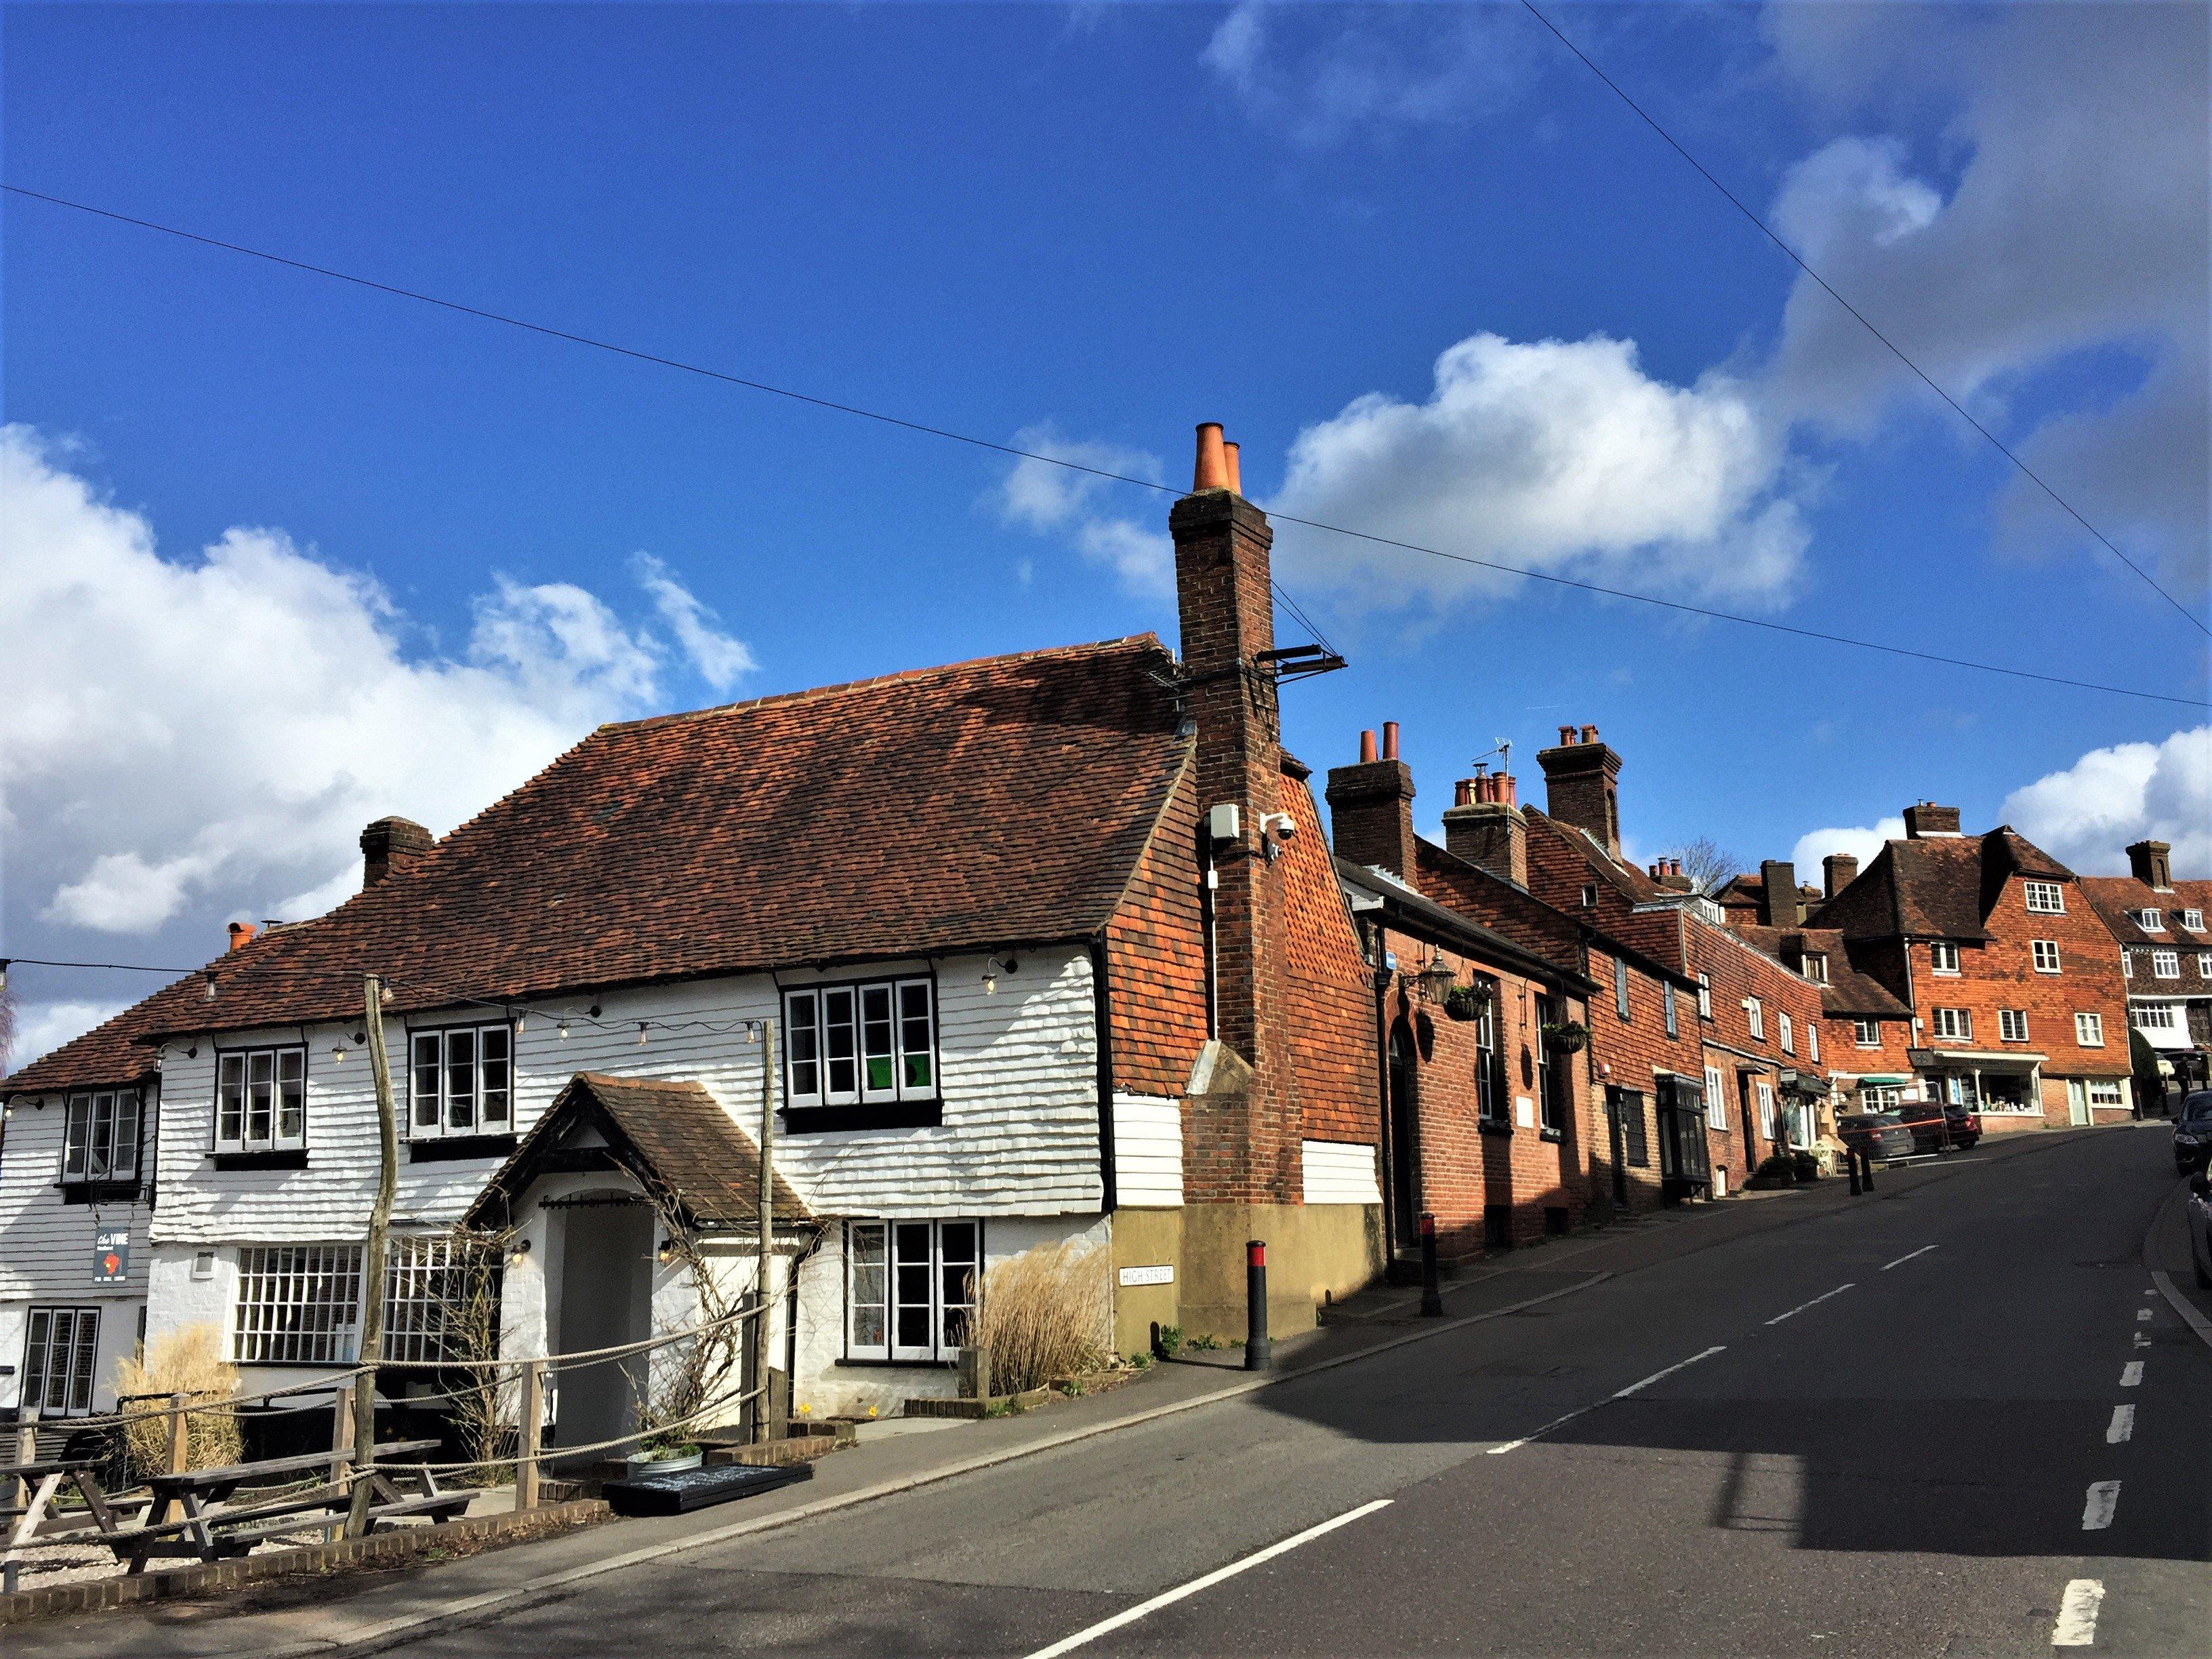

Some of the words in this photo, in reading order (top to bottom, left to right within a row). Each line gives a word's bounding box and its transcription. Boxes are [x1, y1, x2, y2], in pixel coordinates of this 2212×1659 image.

[110, 1233, 129, 1245] VINE
[1123, 1270, 1143, 1284] HIGH
[1145, 1268, 1171, 1282] STREET
